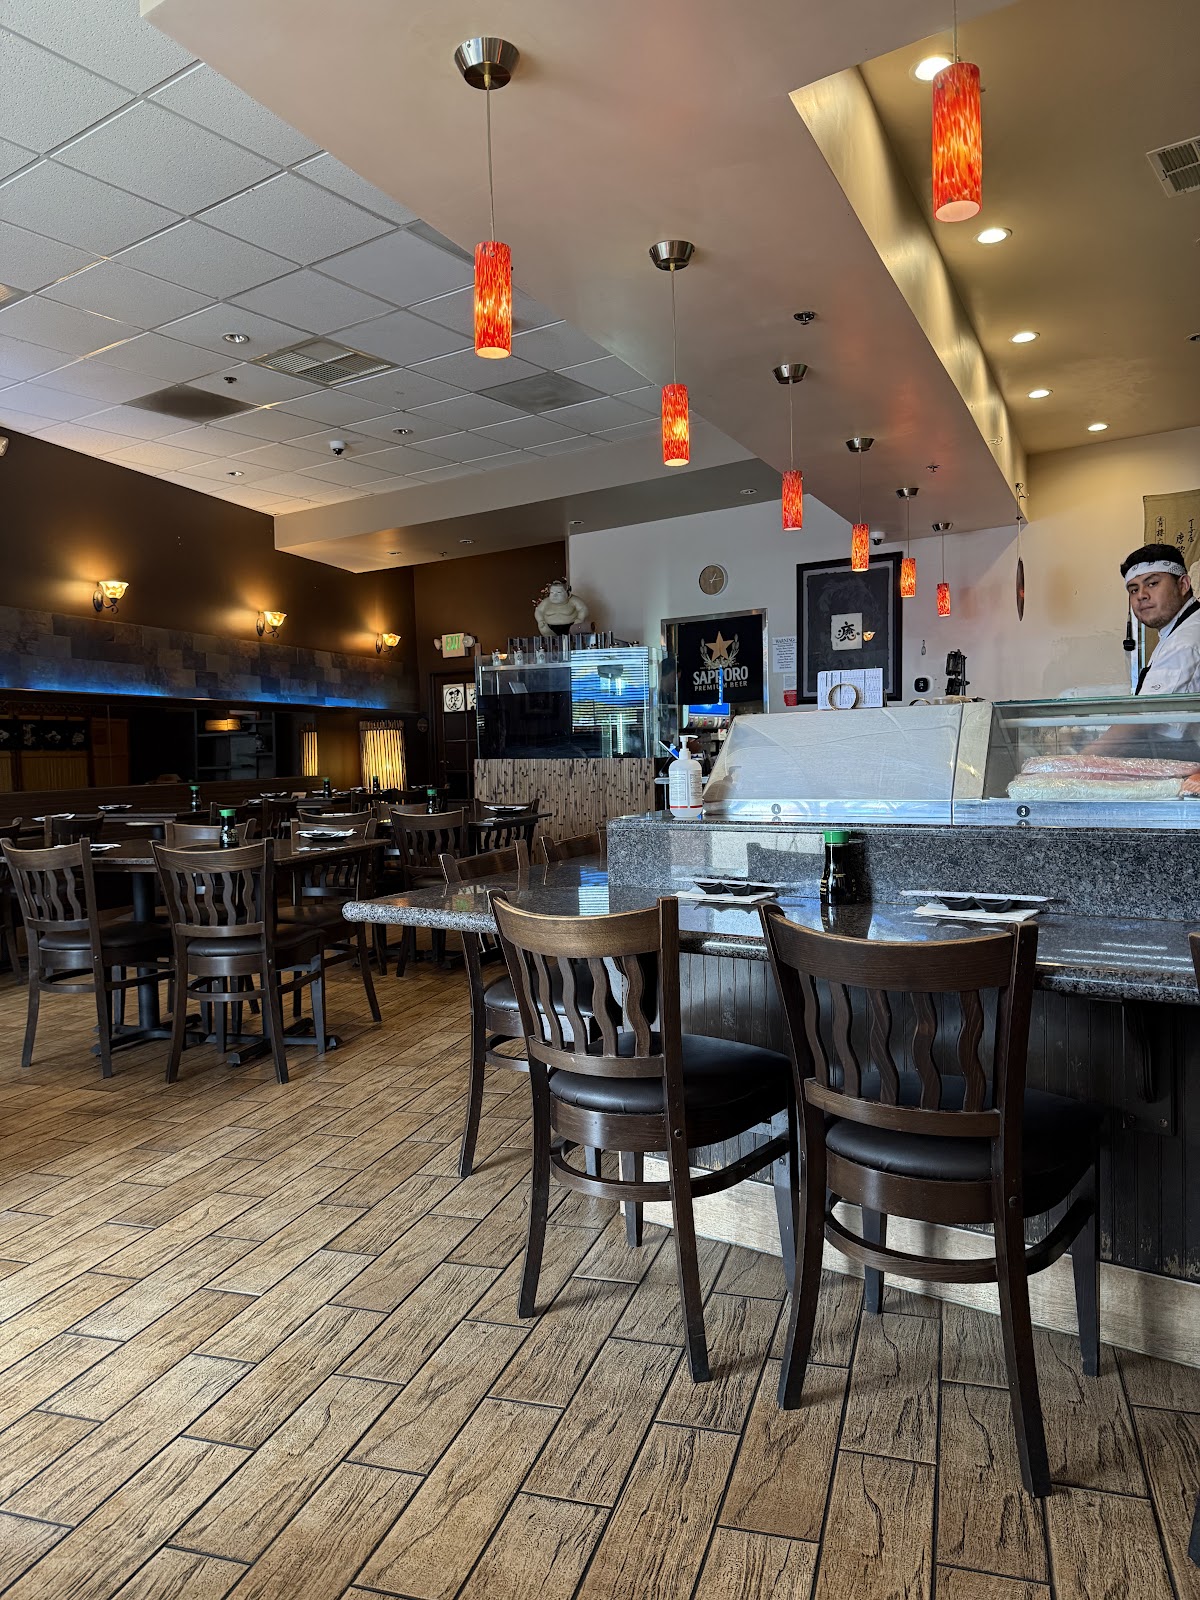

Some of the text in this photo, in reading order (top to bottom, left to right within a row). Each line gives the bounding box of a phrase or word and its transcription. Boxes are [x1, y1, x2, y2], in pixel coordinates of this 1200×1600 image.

[446, 635, 460, 651] EXIT
[693, 666, 749, 685] SAPPORO
[694, 683, 727, 692] PREMIUM
